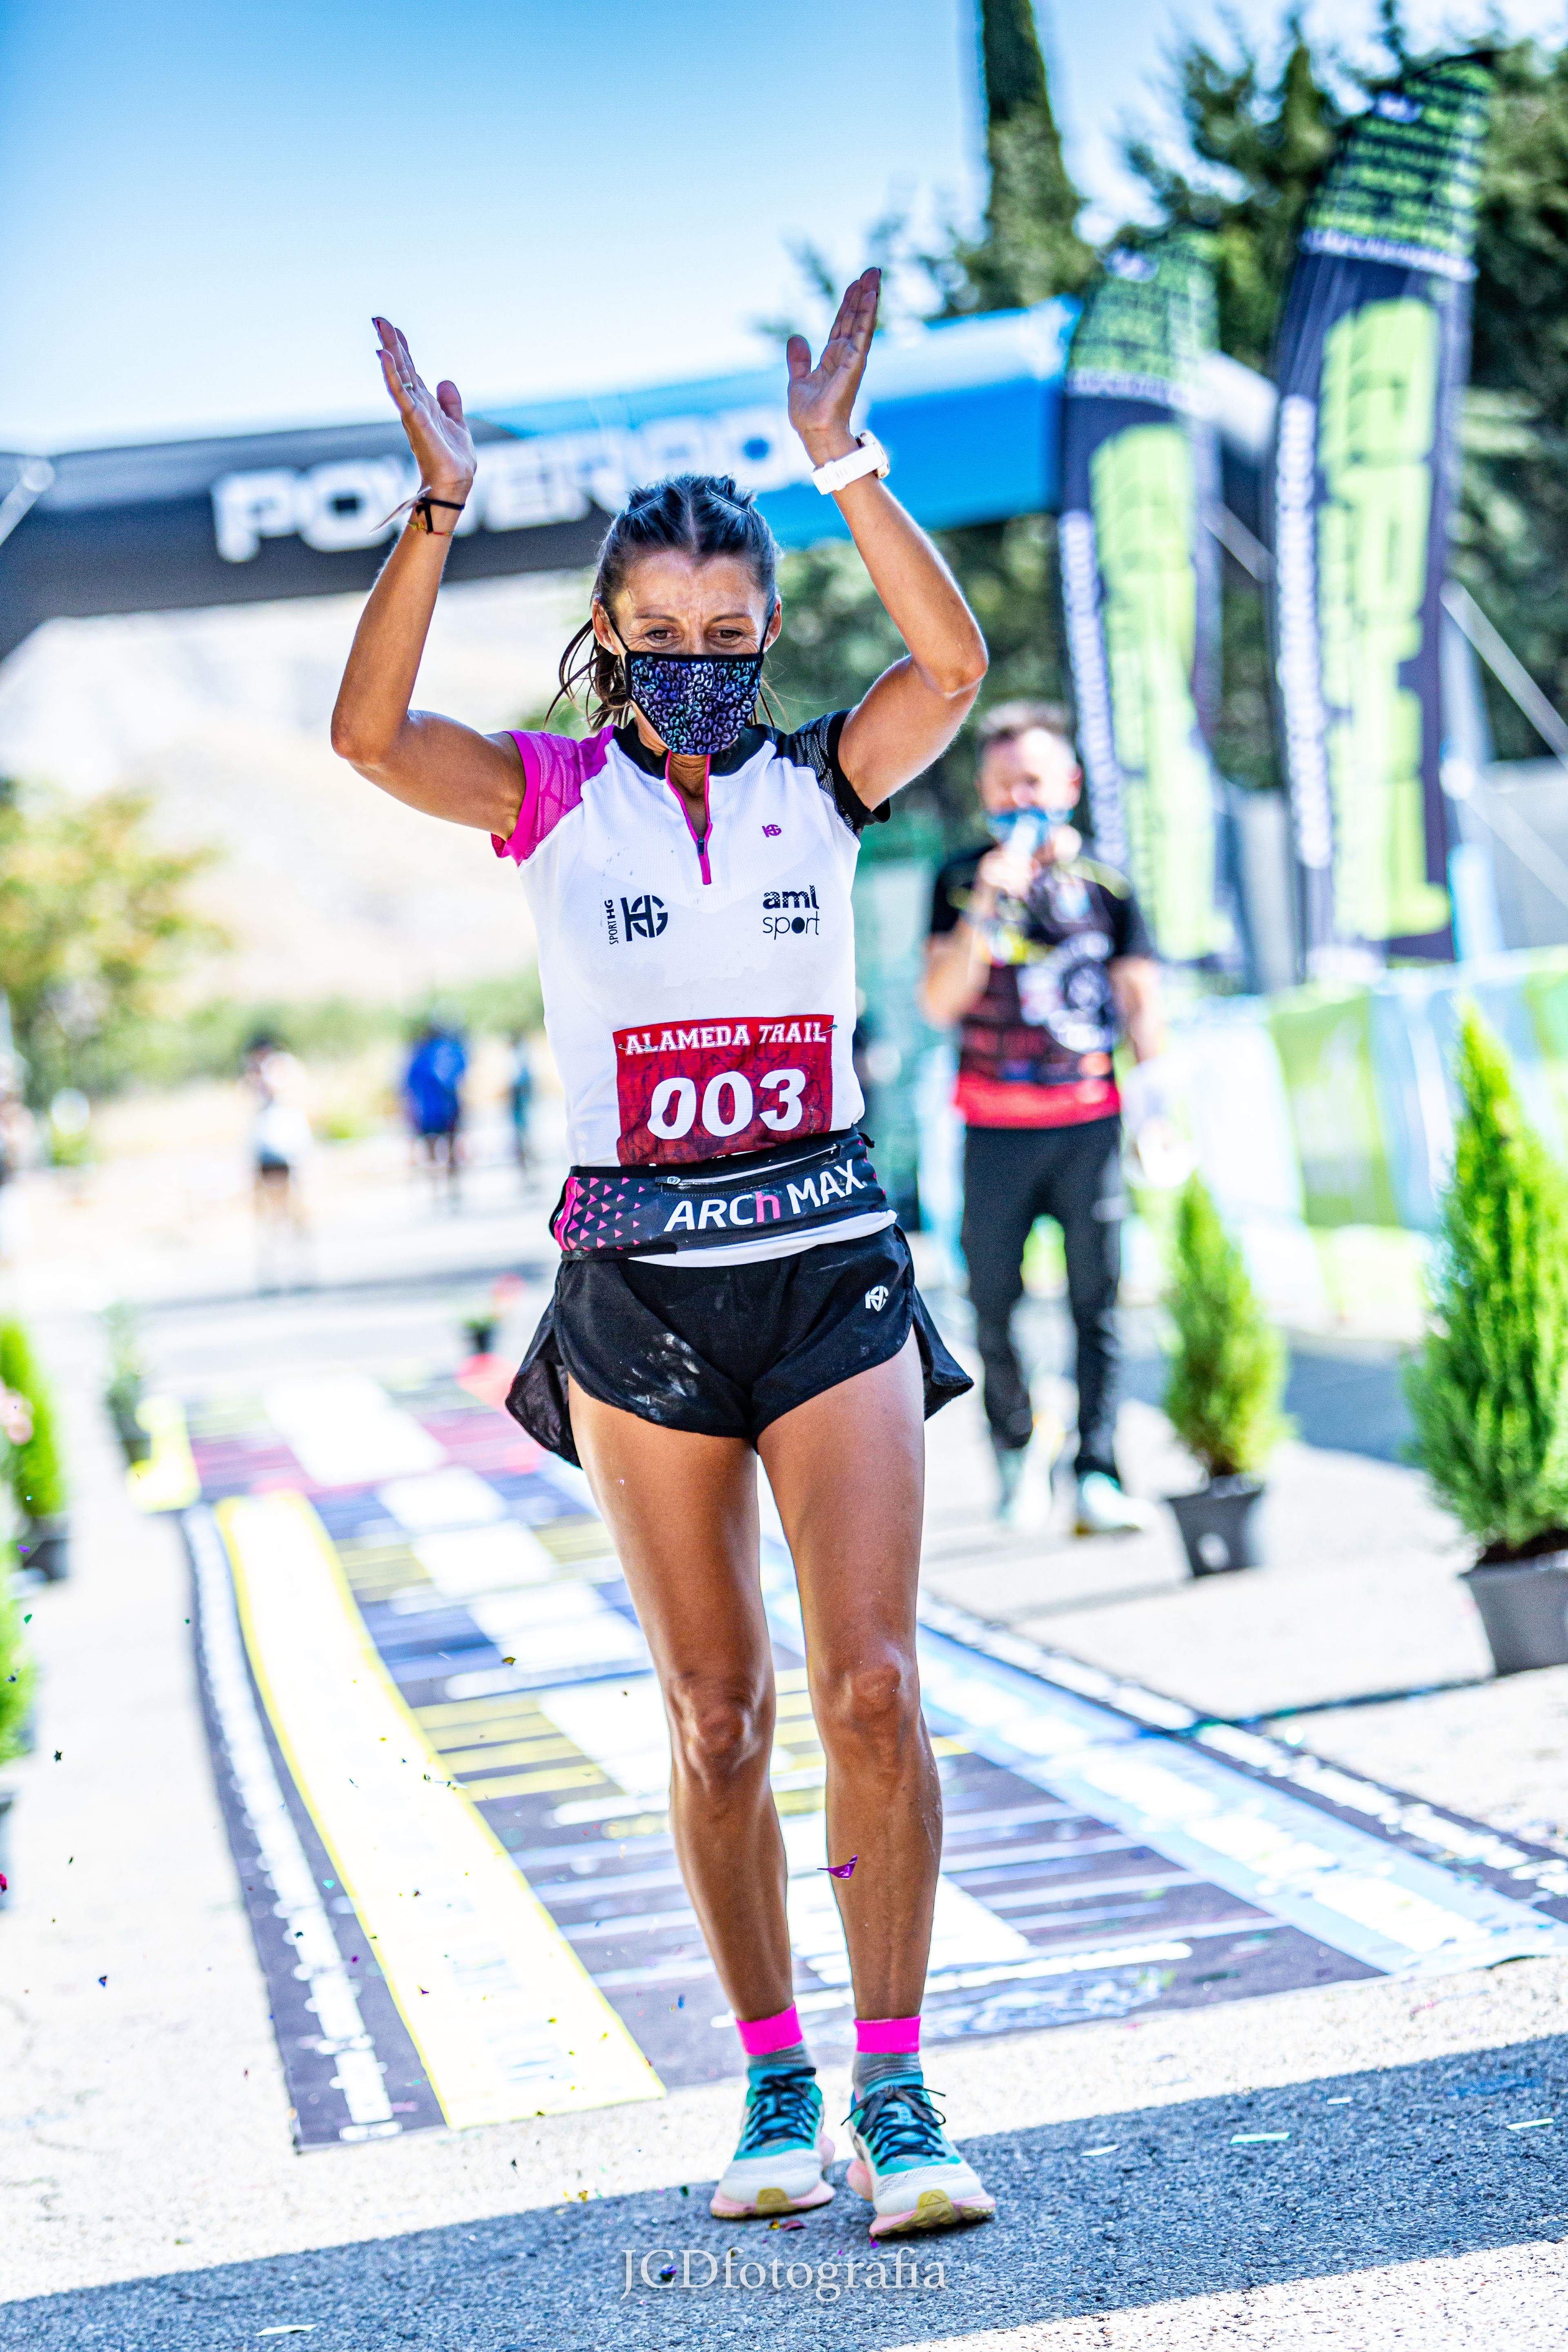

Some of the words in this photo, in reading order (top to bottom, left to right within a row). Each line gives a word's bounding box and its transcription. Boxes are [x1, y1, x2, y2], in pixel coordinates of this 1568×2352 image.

[210, 402, 869, 564] POERAD
[762, 885, 820, 909] aml
[762, 911, 820, 940] sport
[625, 1025, 751, 1056] ALAMEDA
[758, 1022, 827, 1044] TRAIL
[647, 1069, 806, 1140] 003
[786, 1159, 865, 1214] MAX
